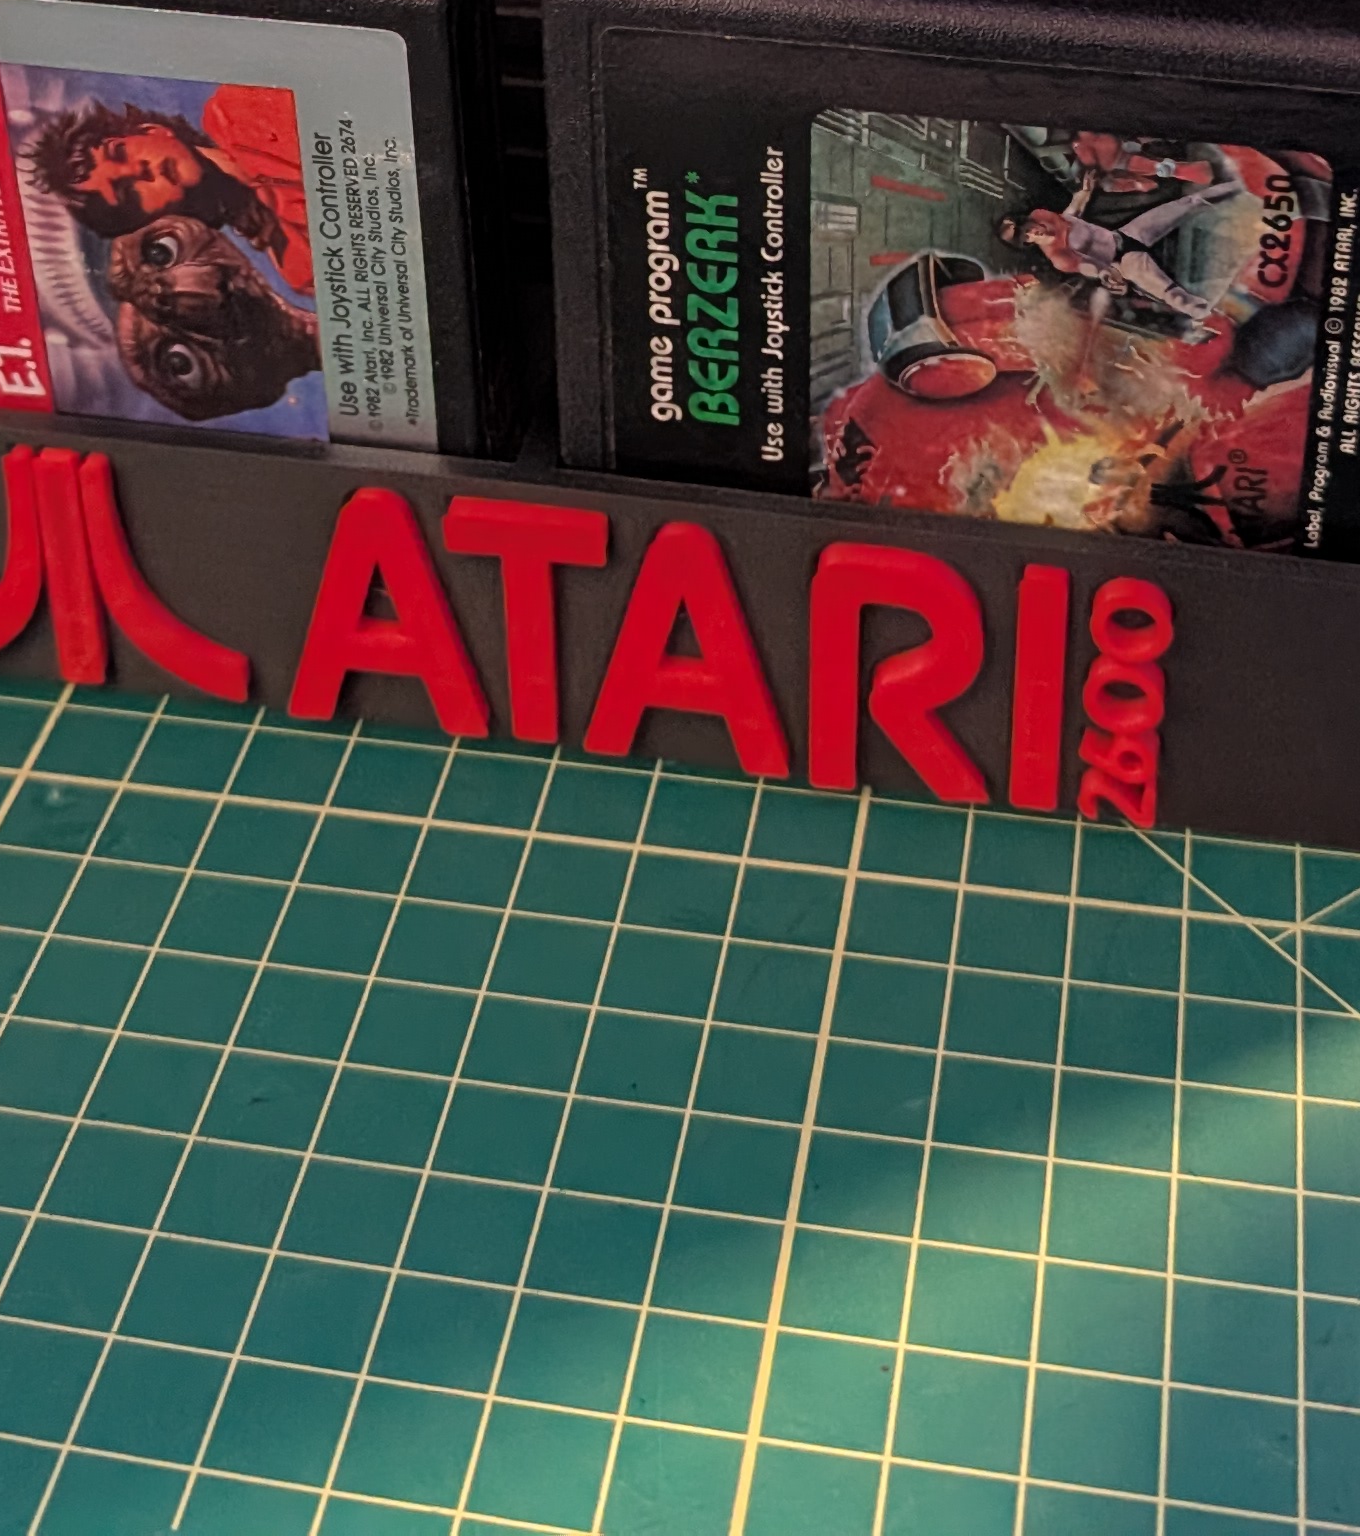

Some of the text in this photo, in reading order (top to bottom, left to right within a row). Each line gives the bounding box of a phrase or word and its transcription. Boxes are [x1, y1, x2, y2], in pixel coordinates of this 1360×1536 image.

[338, 119, 357, 155] 2674
[383, 136, 398, 163] Inc.
[363, 153, 378, 181] Inc.
[342, 157, 364, 229] RESERVED
[365, 186, 383, 243] Studios,
[386, 168, 404, 224] Studios,
[1338, 187, 1360, 218] INC.
[390, 227, 408, 257] City
[1257, 174, 1296, 289] CX2650
[1332, 224, 1359, 272] ATARI,
[311, 131, 360, 417] Use with Joystick Controller
[350, 233, 370, 284] RIGHTS
[370, 247, 387, 277] City
[1, 275, 23, 314] THE
[355, 287, 373, 313] ALL
[372, 280, 392, 346] Universal
[392, 259, 412, 324] Universal
[759, 145, 790, 462] Use with Joystick Controller
[1328, 277, 1349, 313] 1982
[361, 316, 375, 343] Inc.
[400, 326, 414, 342] of
[649, 335, 683, 422] game
[1316, 340, 1341, 421] Audiovisual
[1314, 425, 1333, 438] &
[1339, 429, 1358, 455] ALL
[1308, 441, 1331, 503] Program
[1302, 507, 1326, 549] Label,
[289, 486, 1175, 829] ATARI 2600
